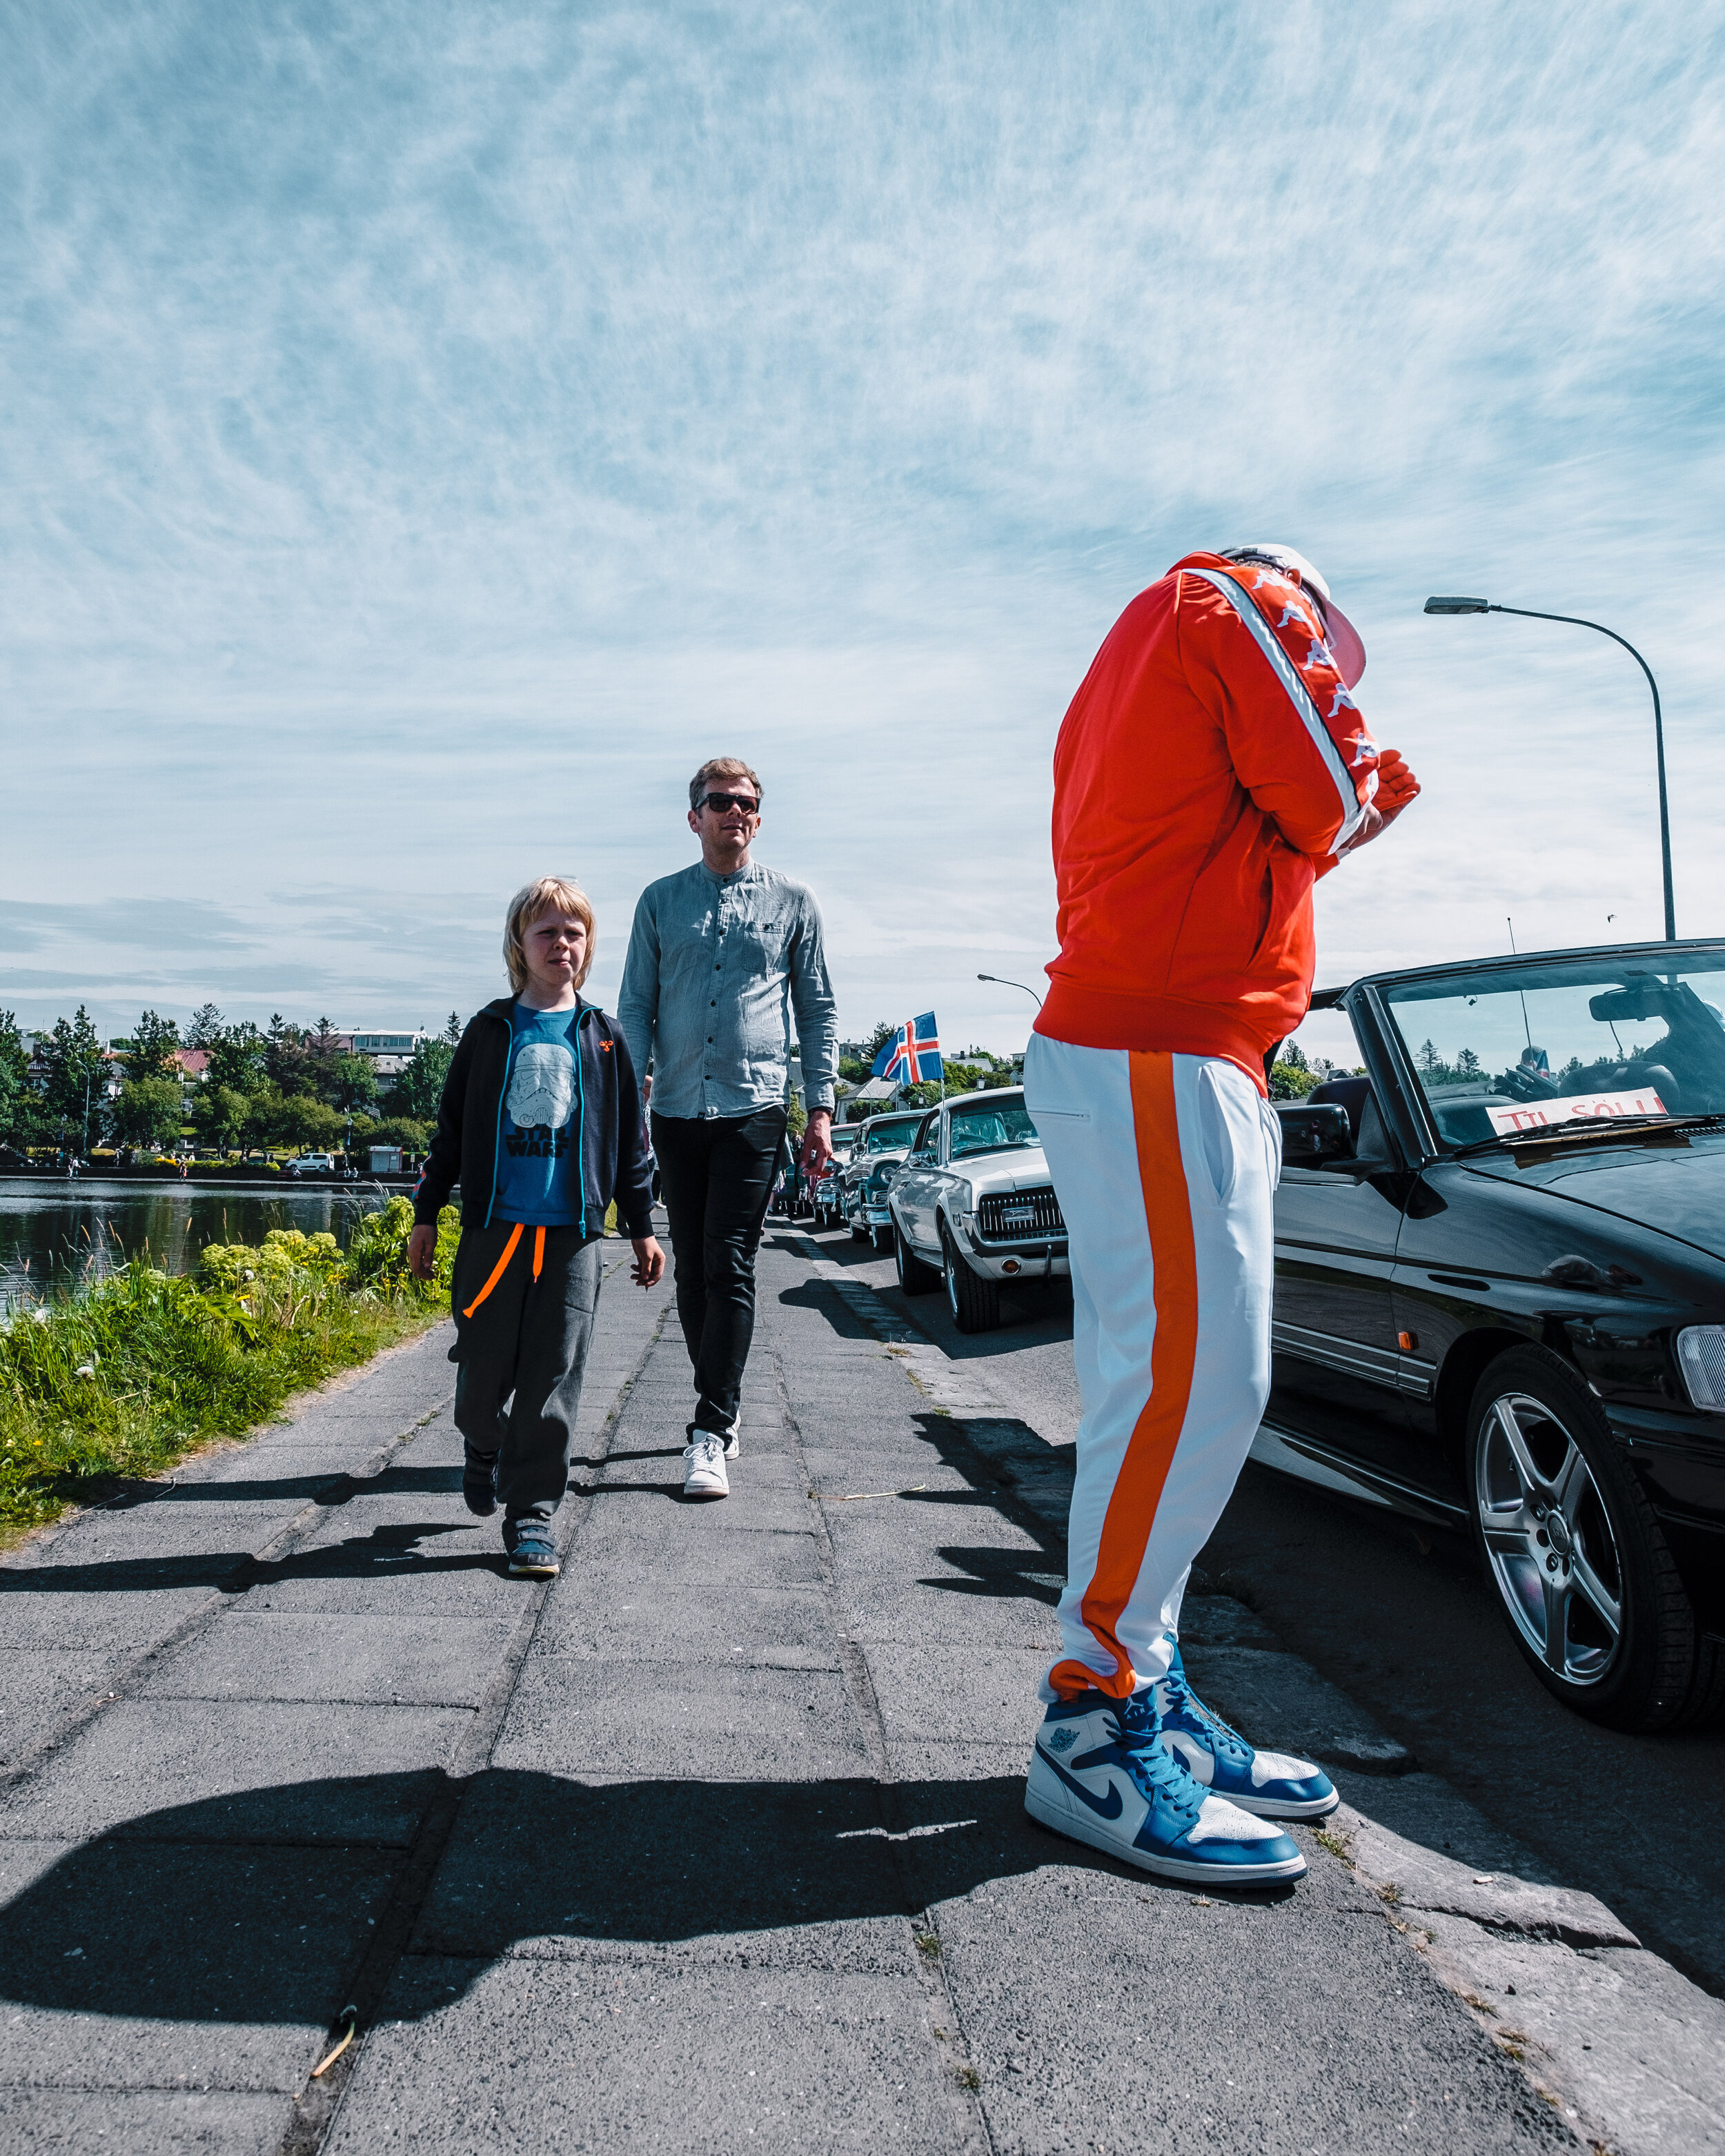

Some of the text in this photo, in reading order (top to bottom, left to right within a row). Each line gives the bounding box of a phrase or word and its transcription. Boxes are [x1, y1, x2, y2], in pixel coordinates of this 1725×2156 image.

[505, 1124, 569, 1143] STAR
[505, 1140, 569, 1158] WARS
[1126, 1708, 1145, 1720] AIR
